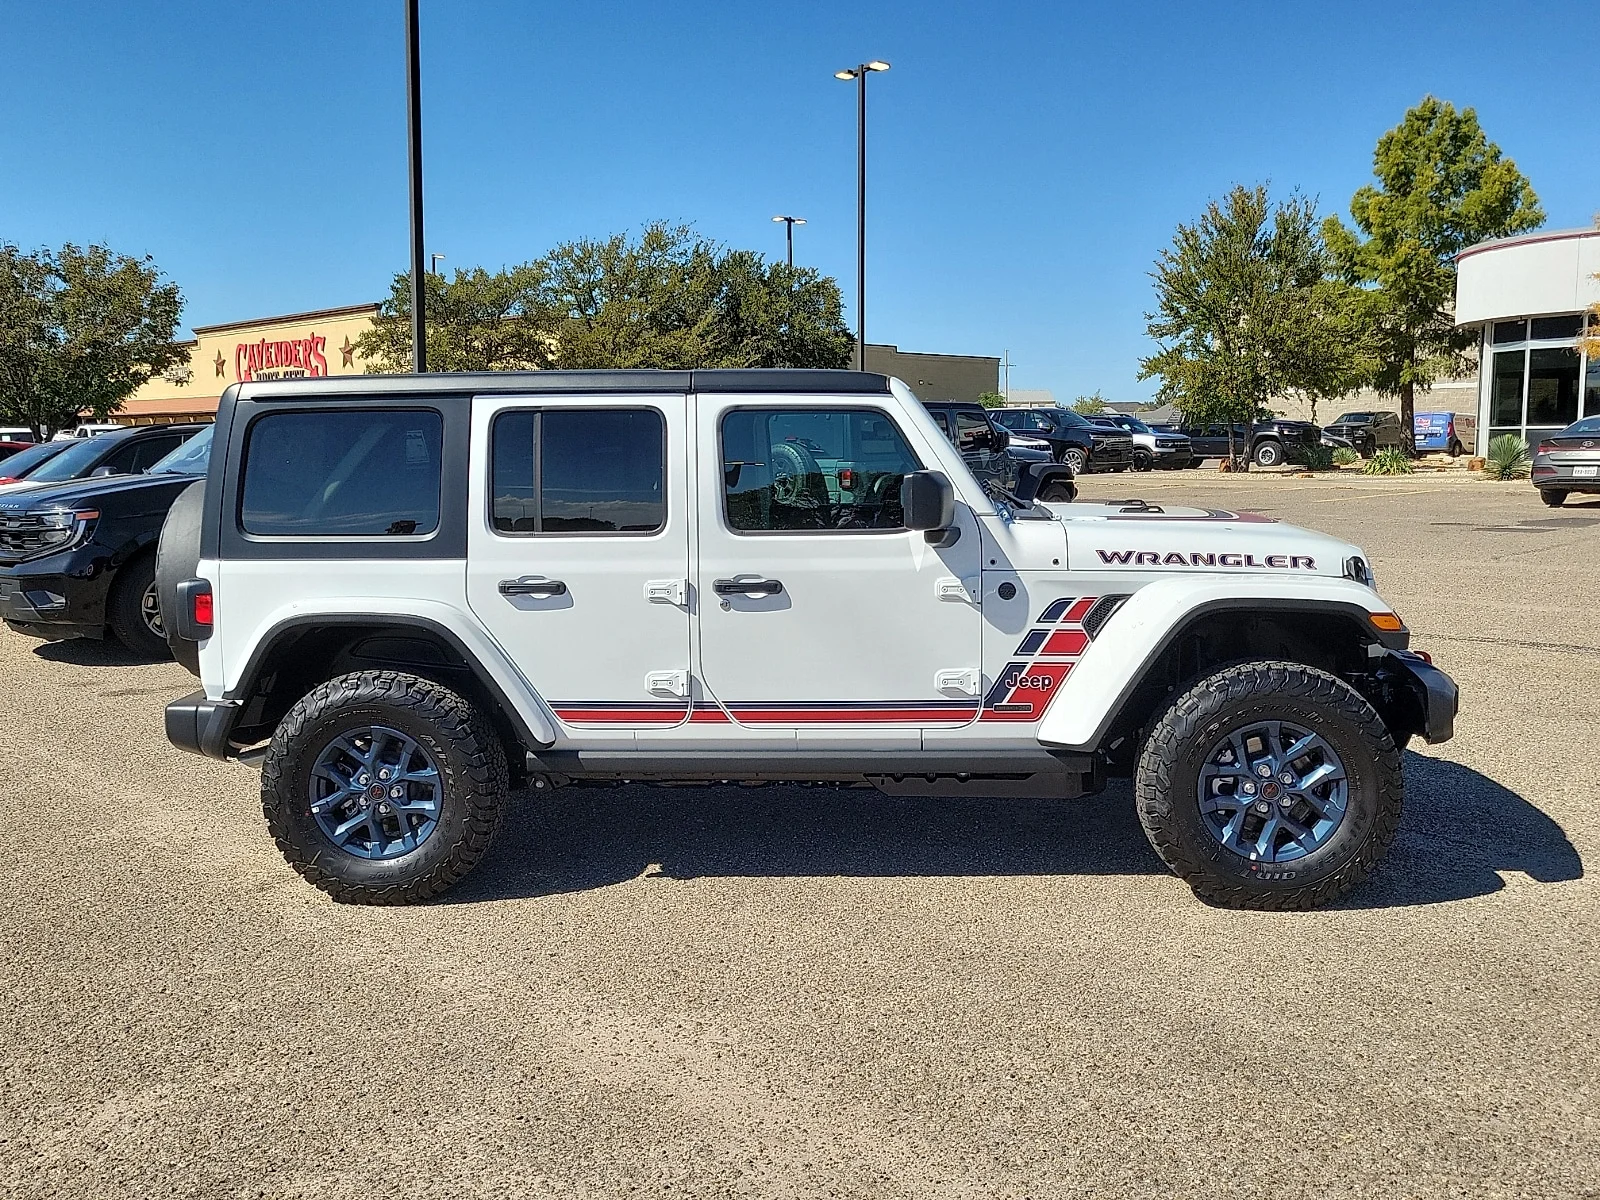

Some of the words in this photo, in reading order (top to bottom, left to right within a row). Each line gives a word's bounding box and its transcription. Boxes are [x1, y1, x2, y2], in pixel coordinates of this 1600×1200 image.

[235, 332, 328, 382] CAVENDER'S
[1095, 549, 1318, 570] WRANGLER
[1005, 671, 1053, 691] Jeep
